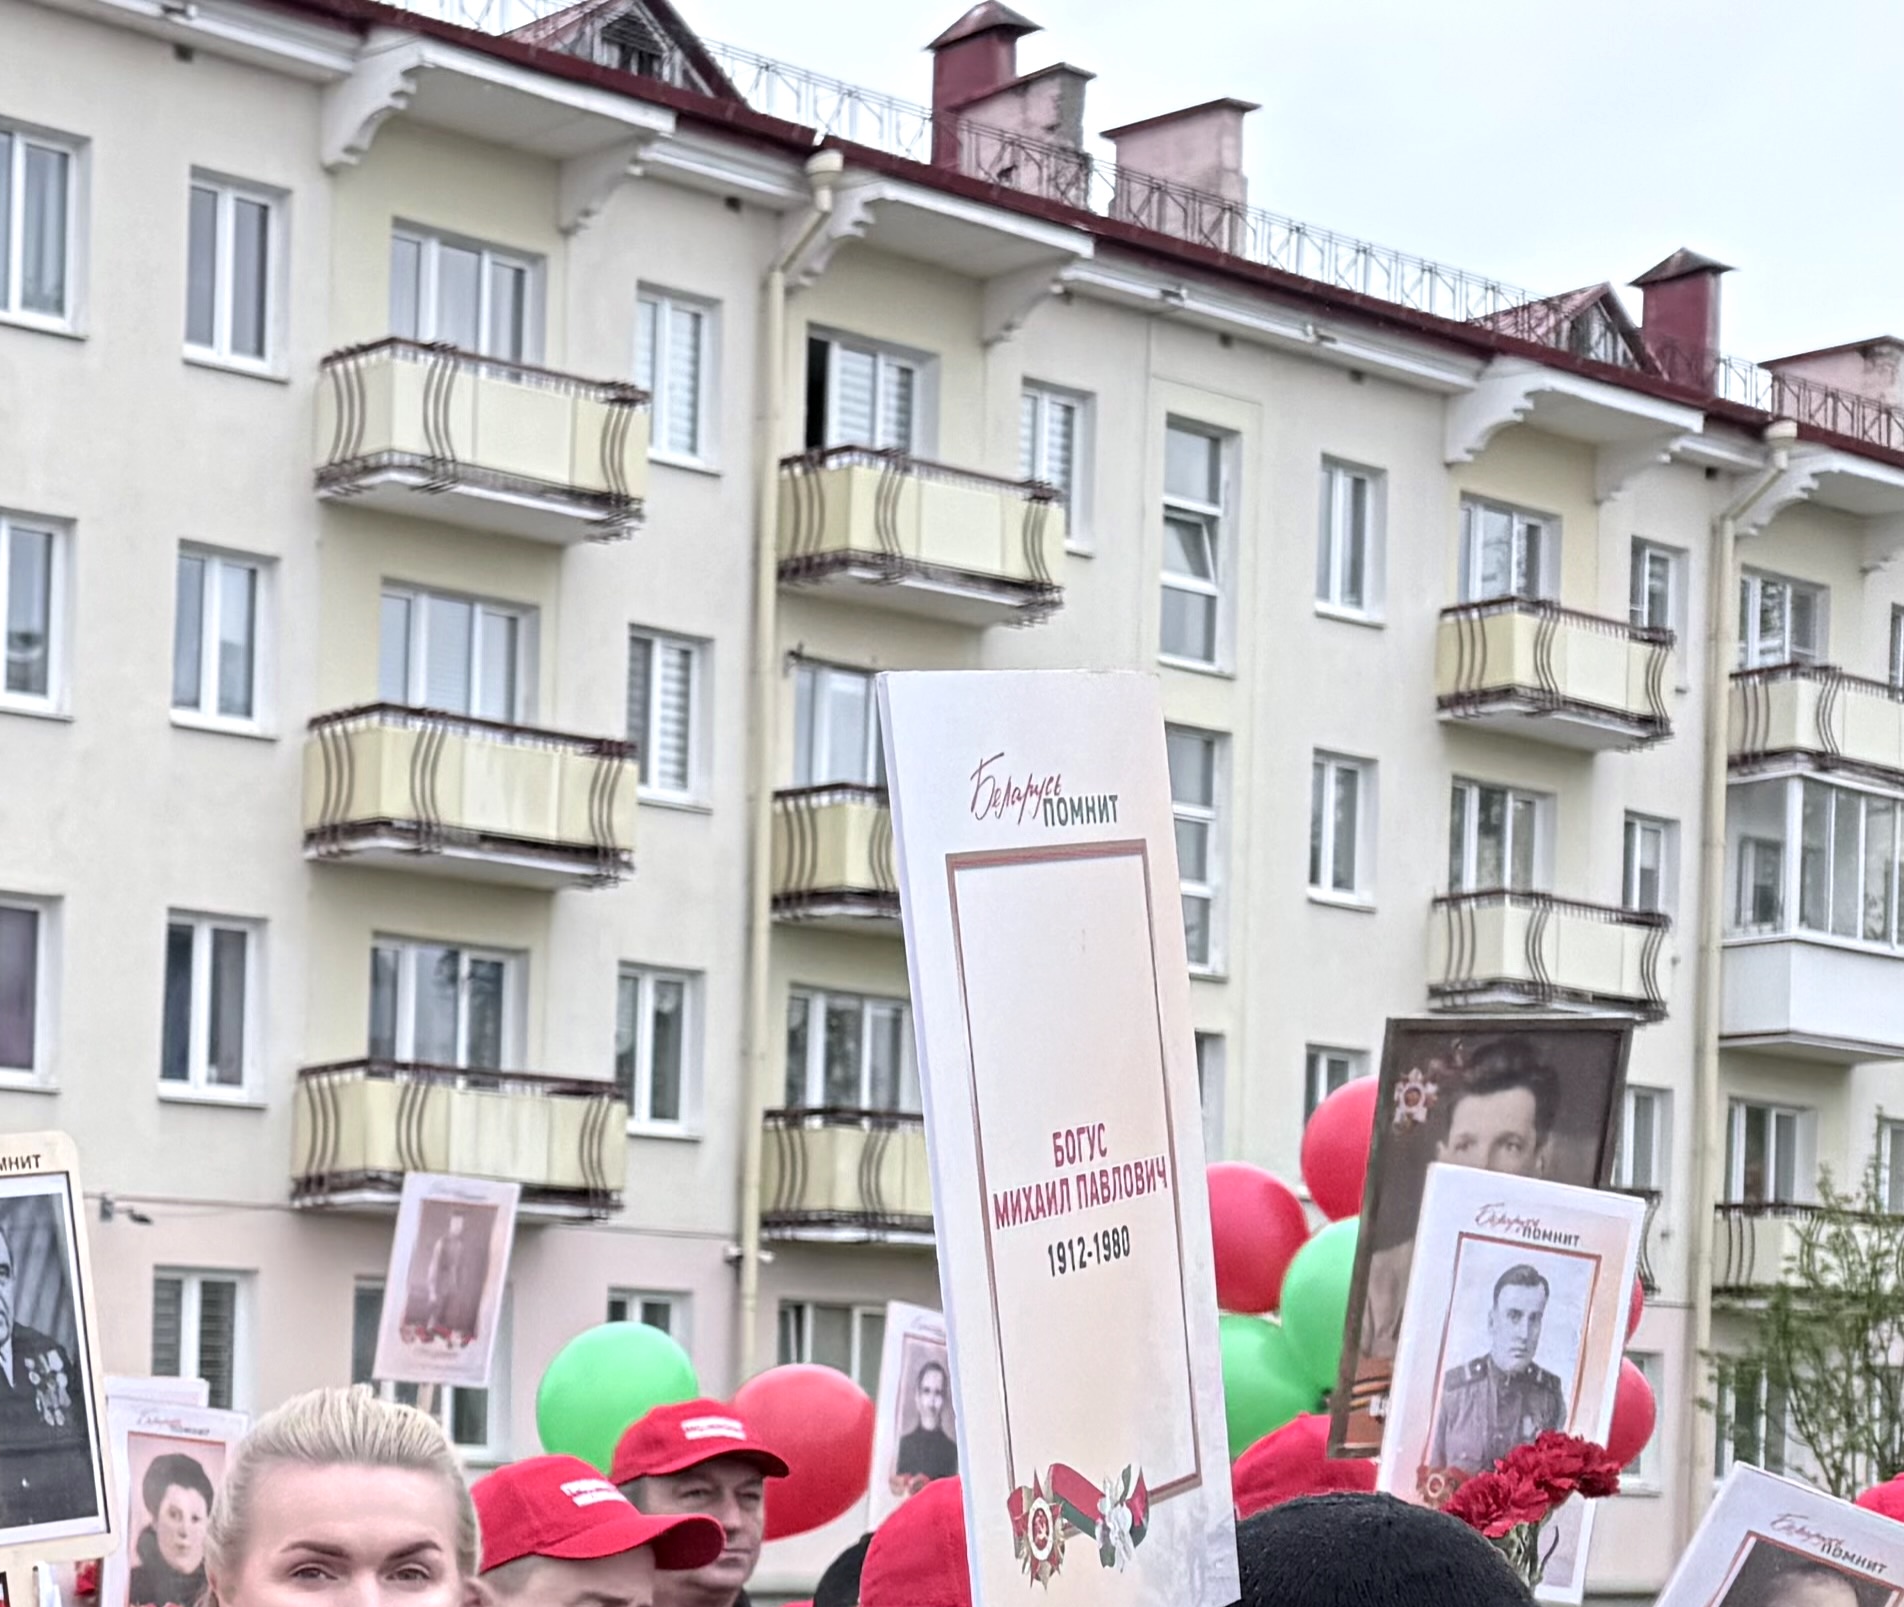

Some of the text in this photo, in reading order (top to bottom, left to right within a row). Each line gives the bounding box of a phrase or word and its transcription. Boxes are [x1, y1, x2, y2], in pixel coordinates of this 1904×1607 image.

[969, 751, 1062, 827] Беларусь
[1042, 794, 1119, 828] ПОМНИТ
[1052, 1122, 1108, 1168] БОГУС
[992, 1154, 1168, 1230] МИХАИЛ ПАВЛОВИЧ
[1047, 1224, 1131, 1278] 1912-1980
[1522, 1226, 1581, 1247] ПОМНИТ
[1820, 1543, 1888, 1575] ПОМНИТ
